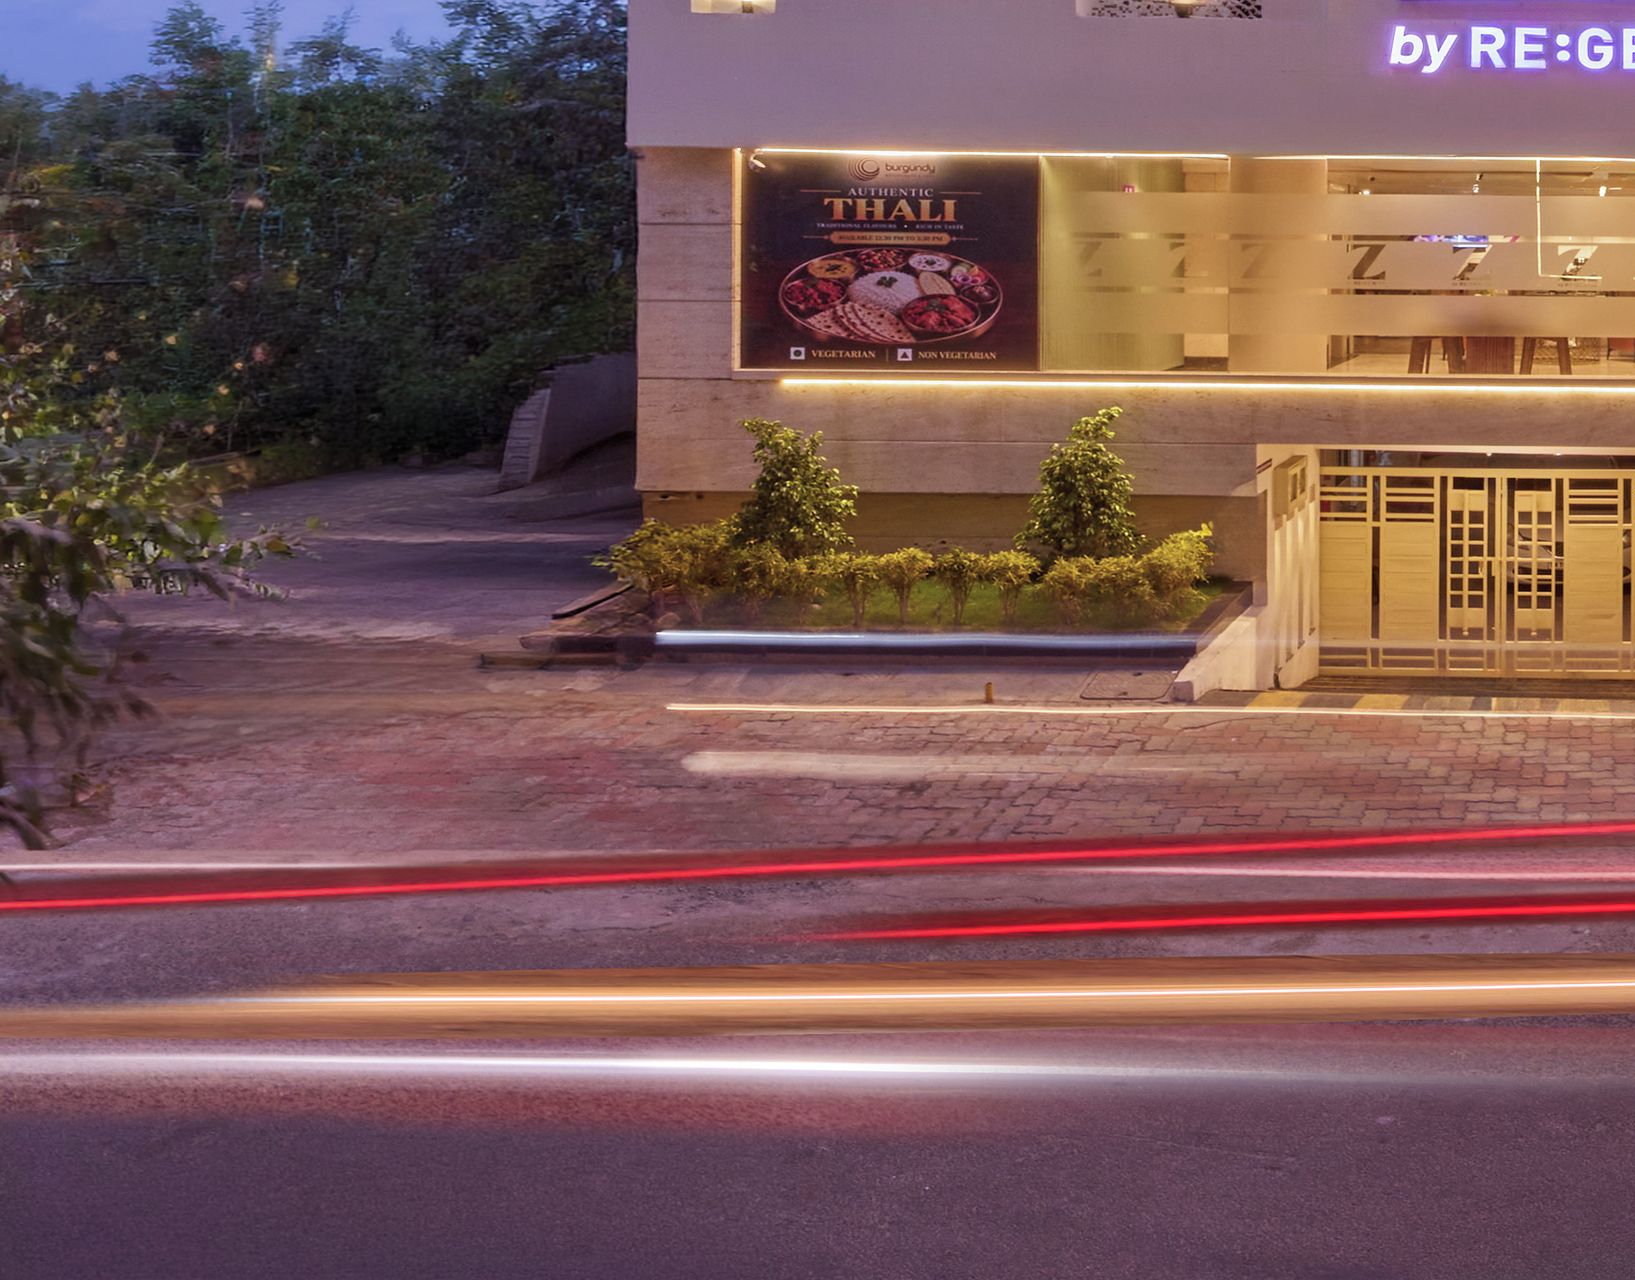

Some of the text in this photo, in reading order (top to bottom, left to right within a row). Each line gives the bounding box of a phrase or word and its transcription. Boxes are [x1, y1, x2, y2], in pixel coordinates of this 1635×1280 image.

[1389, 26, 1457, 74] by
[885, 162, 936, 174] burgundy
[848, 188, 934, 197] AUTHENTIC
[823, 197, 958, 222] THALI
[1353, 244, 1386, 280] Z
[811, 349, 876, 358] VEGETARIAN
[918, 351, 997, 360] NON VEGETARIAN
